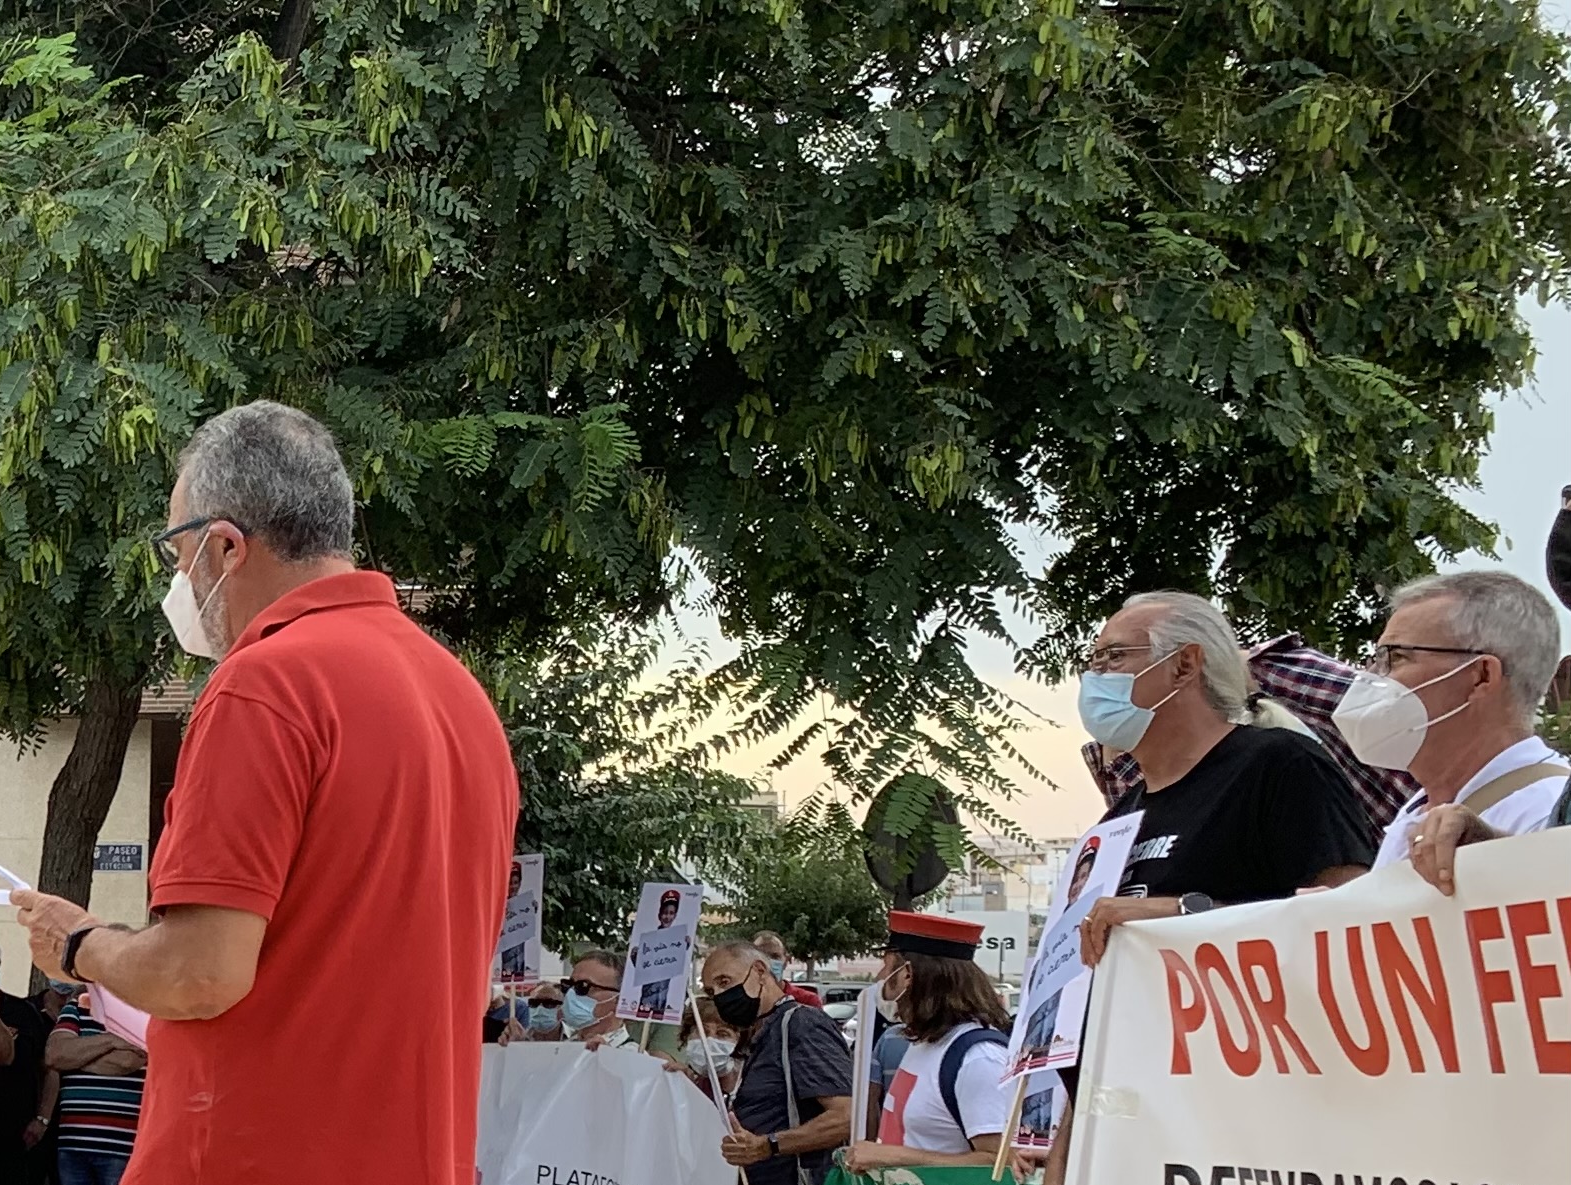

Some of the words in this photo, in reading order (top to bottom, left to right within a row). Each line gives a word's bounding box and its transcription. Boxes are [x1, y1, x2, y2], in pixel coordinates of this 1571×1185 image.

[108, 846, 137, 855] PASEO
[977, 937, 1015, 950] sa
[1158, 939, 1323, 1077] POR
[1314, 915, 1461, 1077] UN
[1463, 897, 1571, 1075] FE
